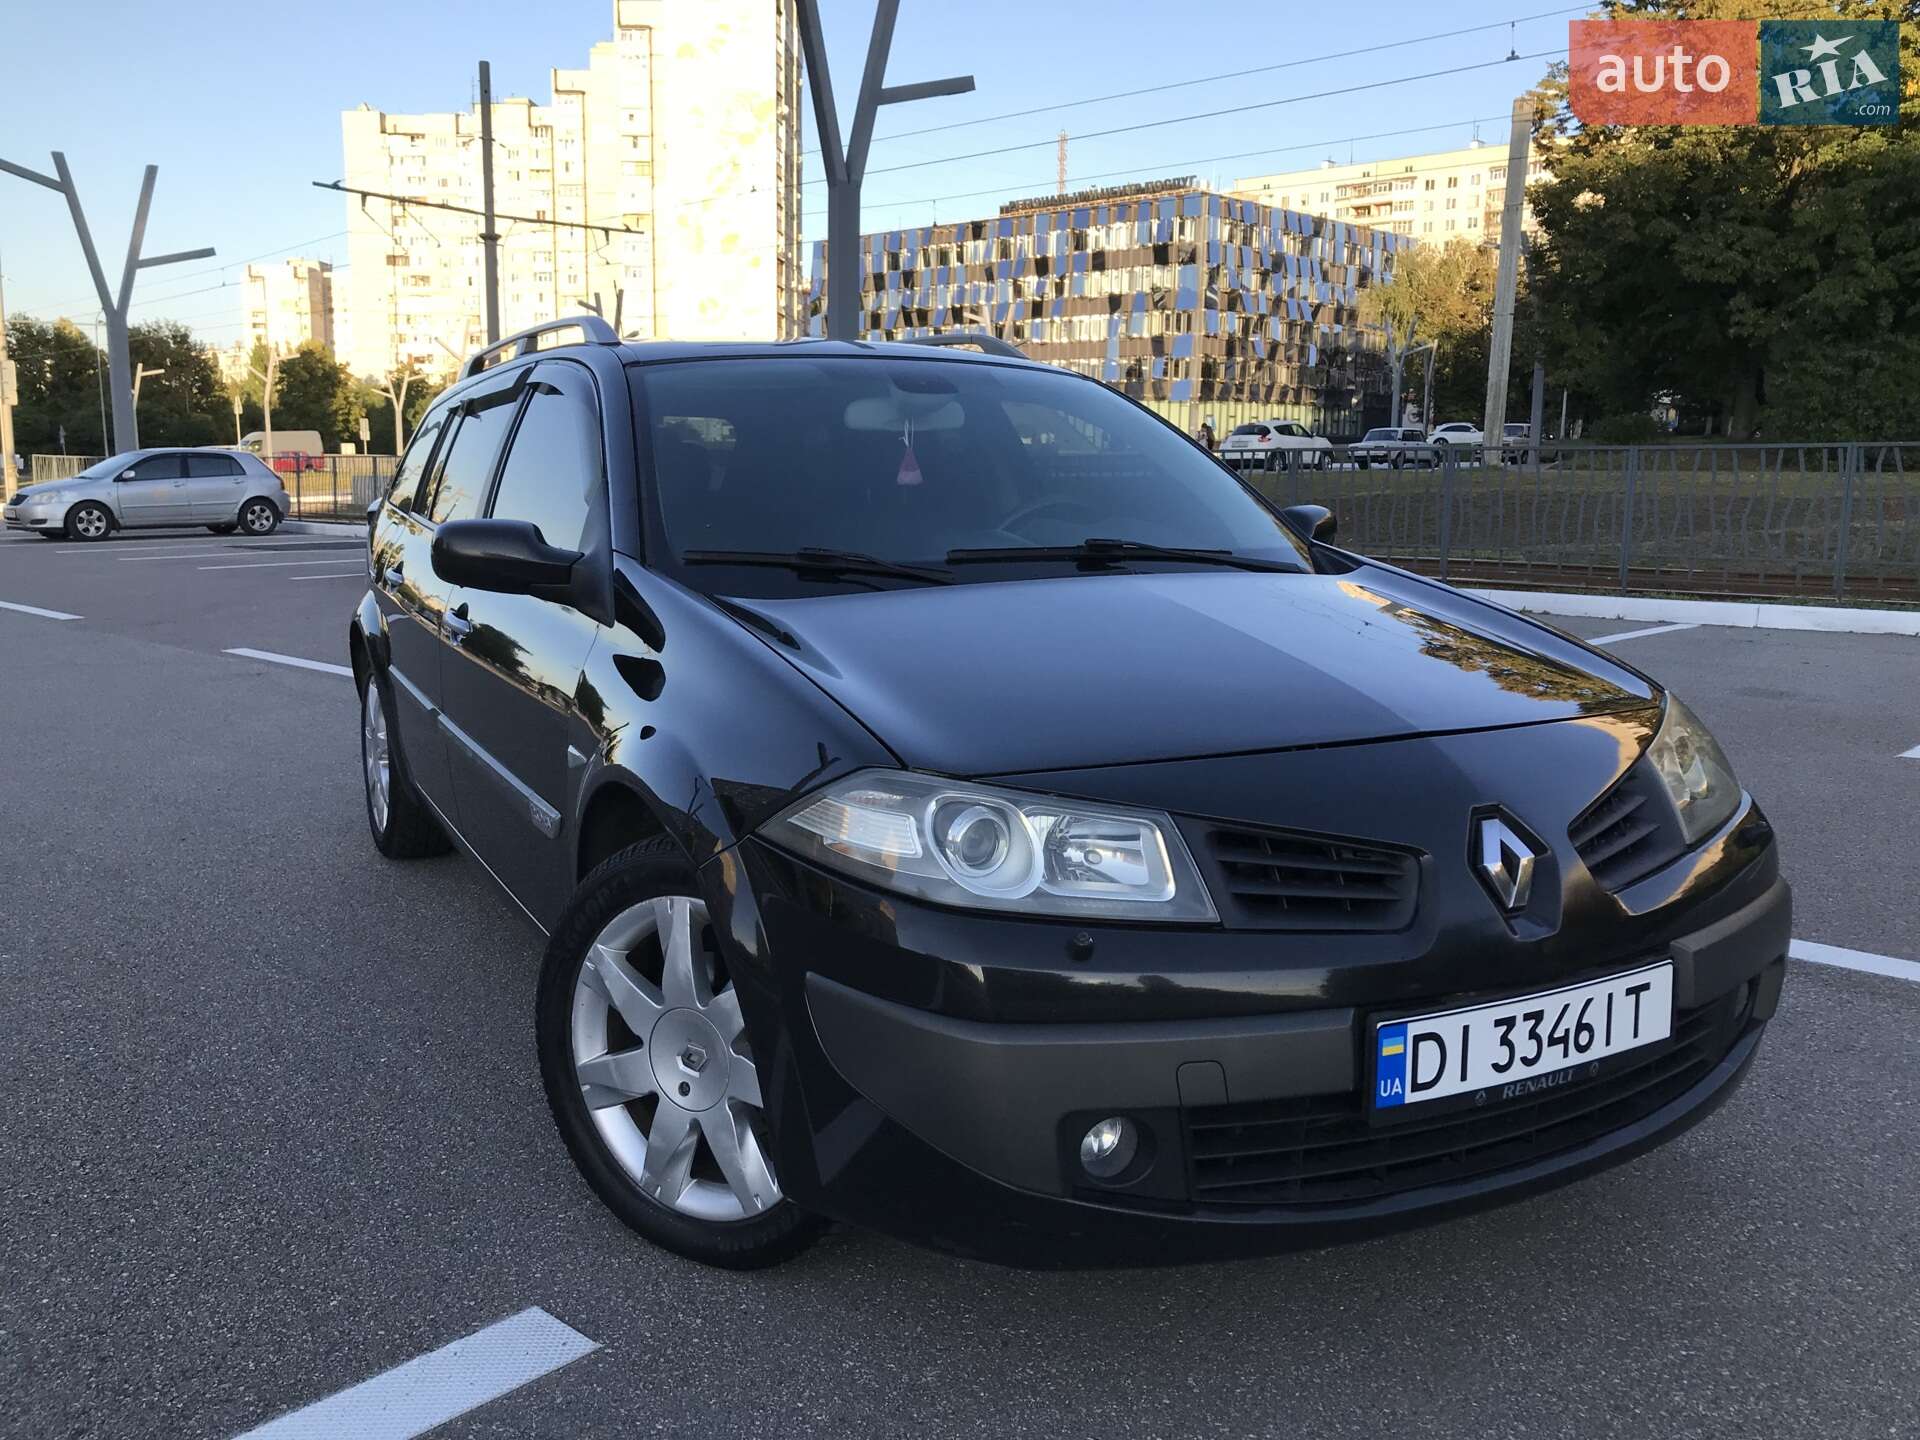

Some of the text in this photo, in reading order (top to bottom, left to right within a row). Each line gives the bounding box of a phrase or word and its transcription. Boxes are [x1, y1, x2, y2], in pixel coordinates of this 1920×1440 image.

[1144, 174, 1197, 194] ПОСЛУГ
[1410, 1024, 1471, 1094] DI
[1380, 1079, 1402, 1098] UA
[1502, 1069, 1574, 1100] RENAULT
